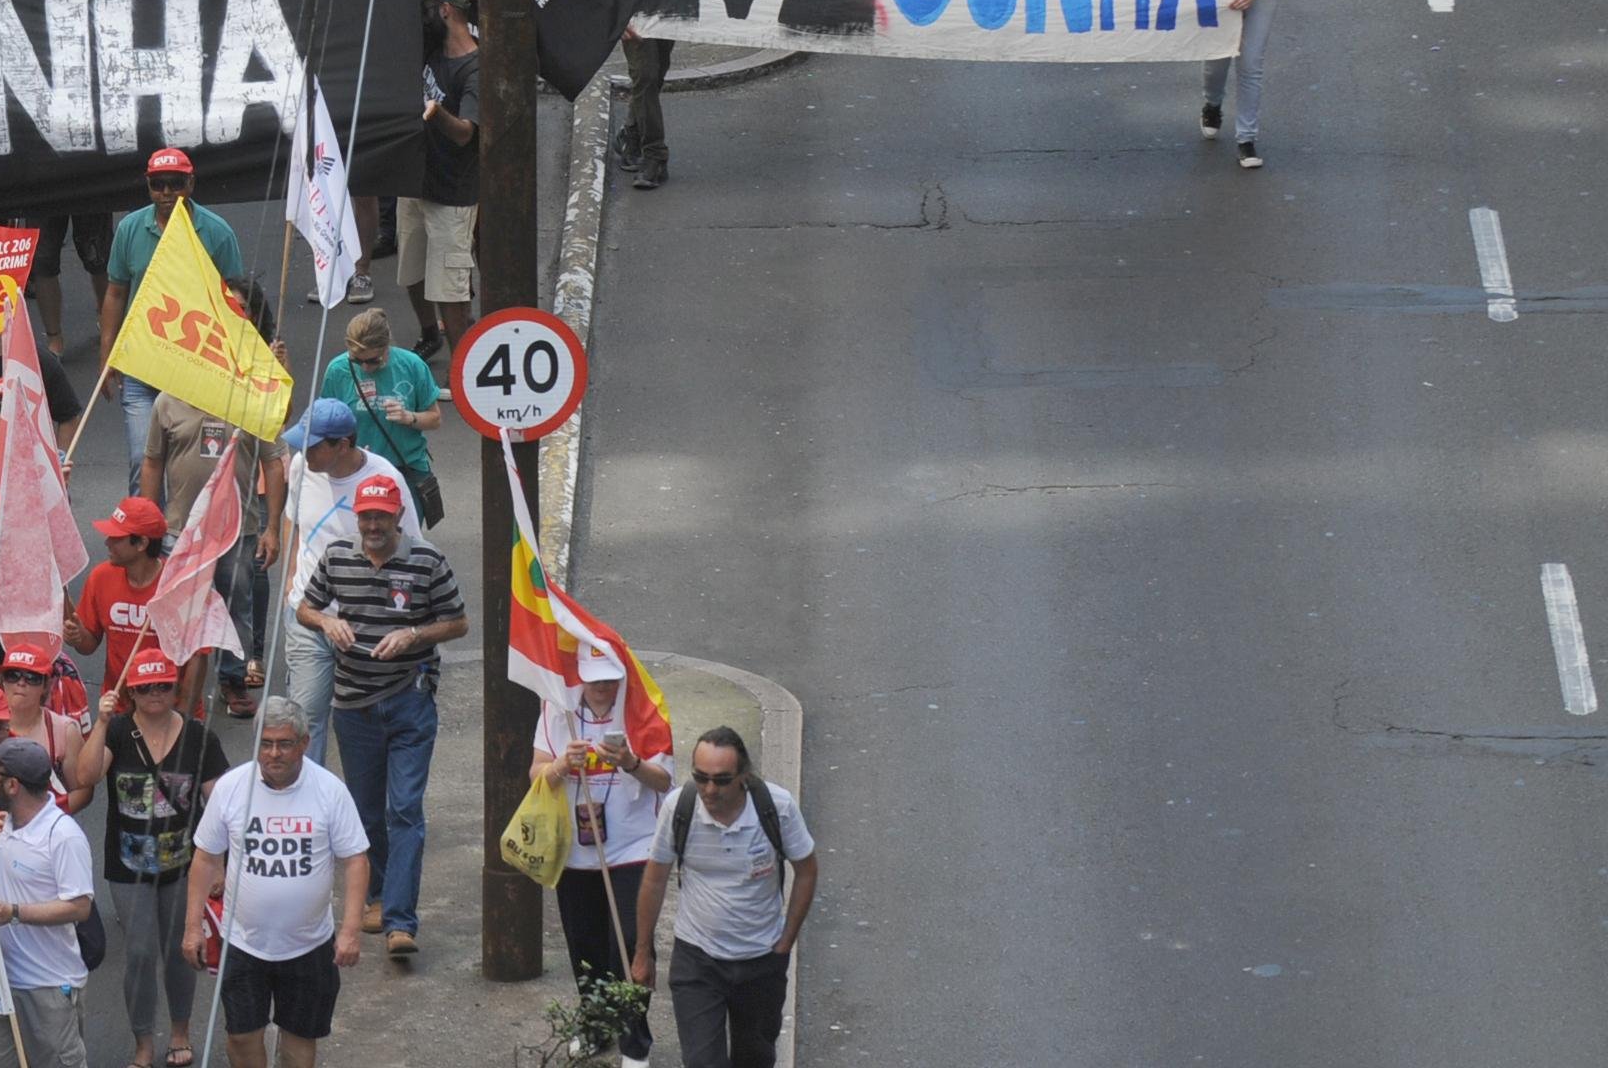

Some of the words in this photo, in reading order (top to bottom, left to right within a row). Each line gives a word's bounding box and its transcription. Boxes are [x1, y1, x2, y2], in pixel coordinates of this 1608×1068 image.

[11, 237, 31, 253] 206
[476, 340, 559, 396] 40
[497, 404, 542, 420] km/h
[110, 602, 152, 629] CU
[246, 816, 263, 833] A
[266, 816, 312, 833] CUT
[244, 837, 313, 856] PODE
[245, 856, 313, 878] MAIS
